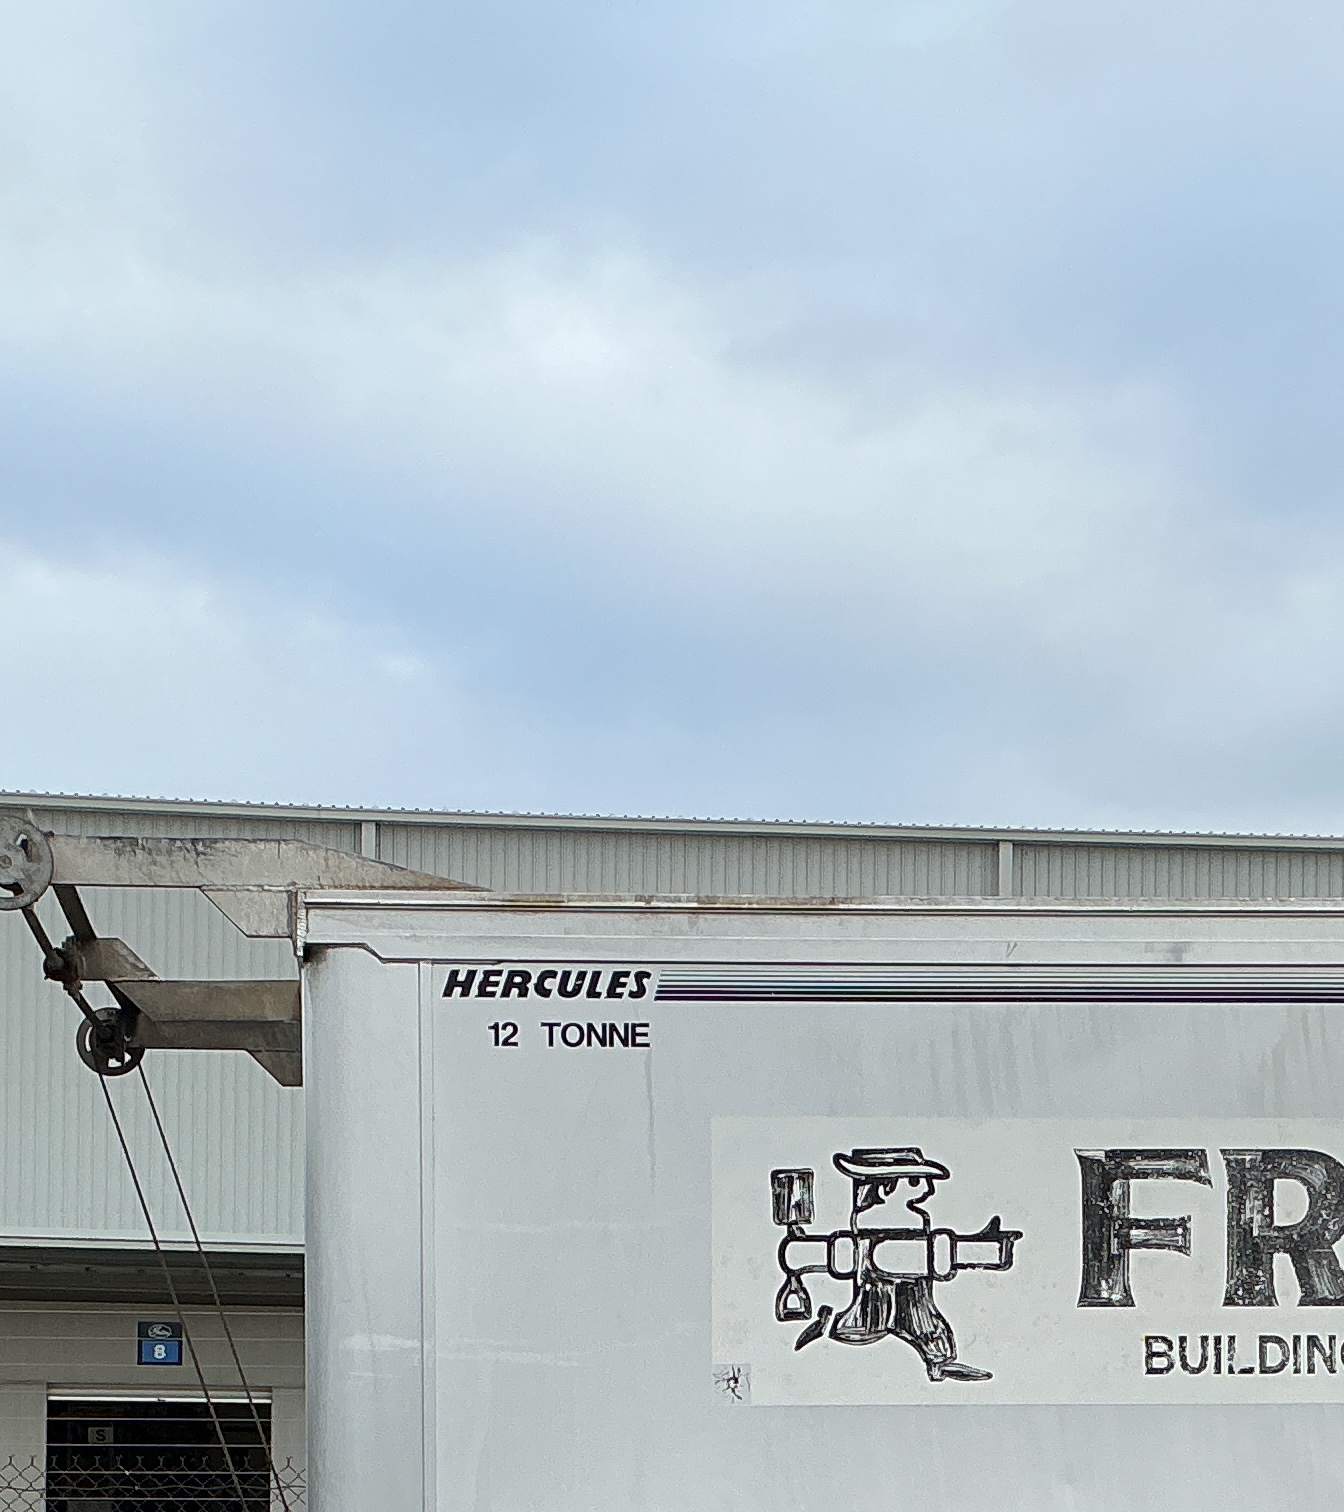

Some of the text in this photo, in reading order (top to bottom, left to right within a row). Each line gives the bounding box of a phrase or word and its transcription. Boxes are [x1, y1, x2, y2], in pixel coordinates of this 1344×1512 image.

[442, 969, 652, 999] HERCULES
[487, 1021, 651, 1048] 12 TONNE
